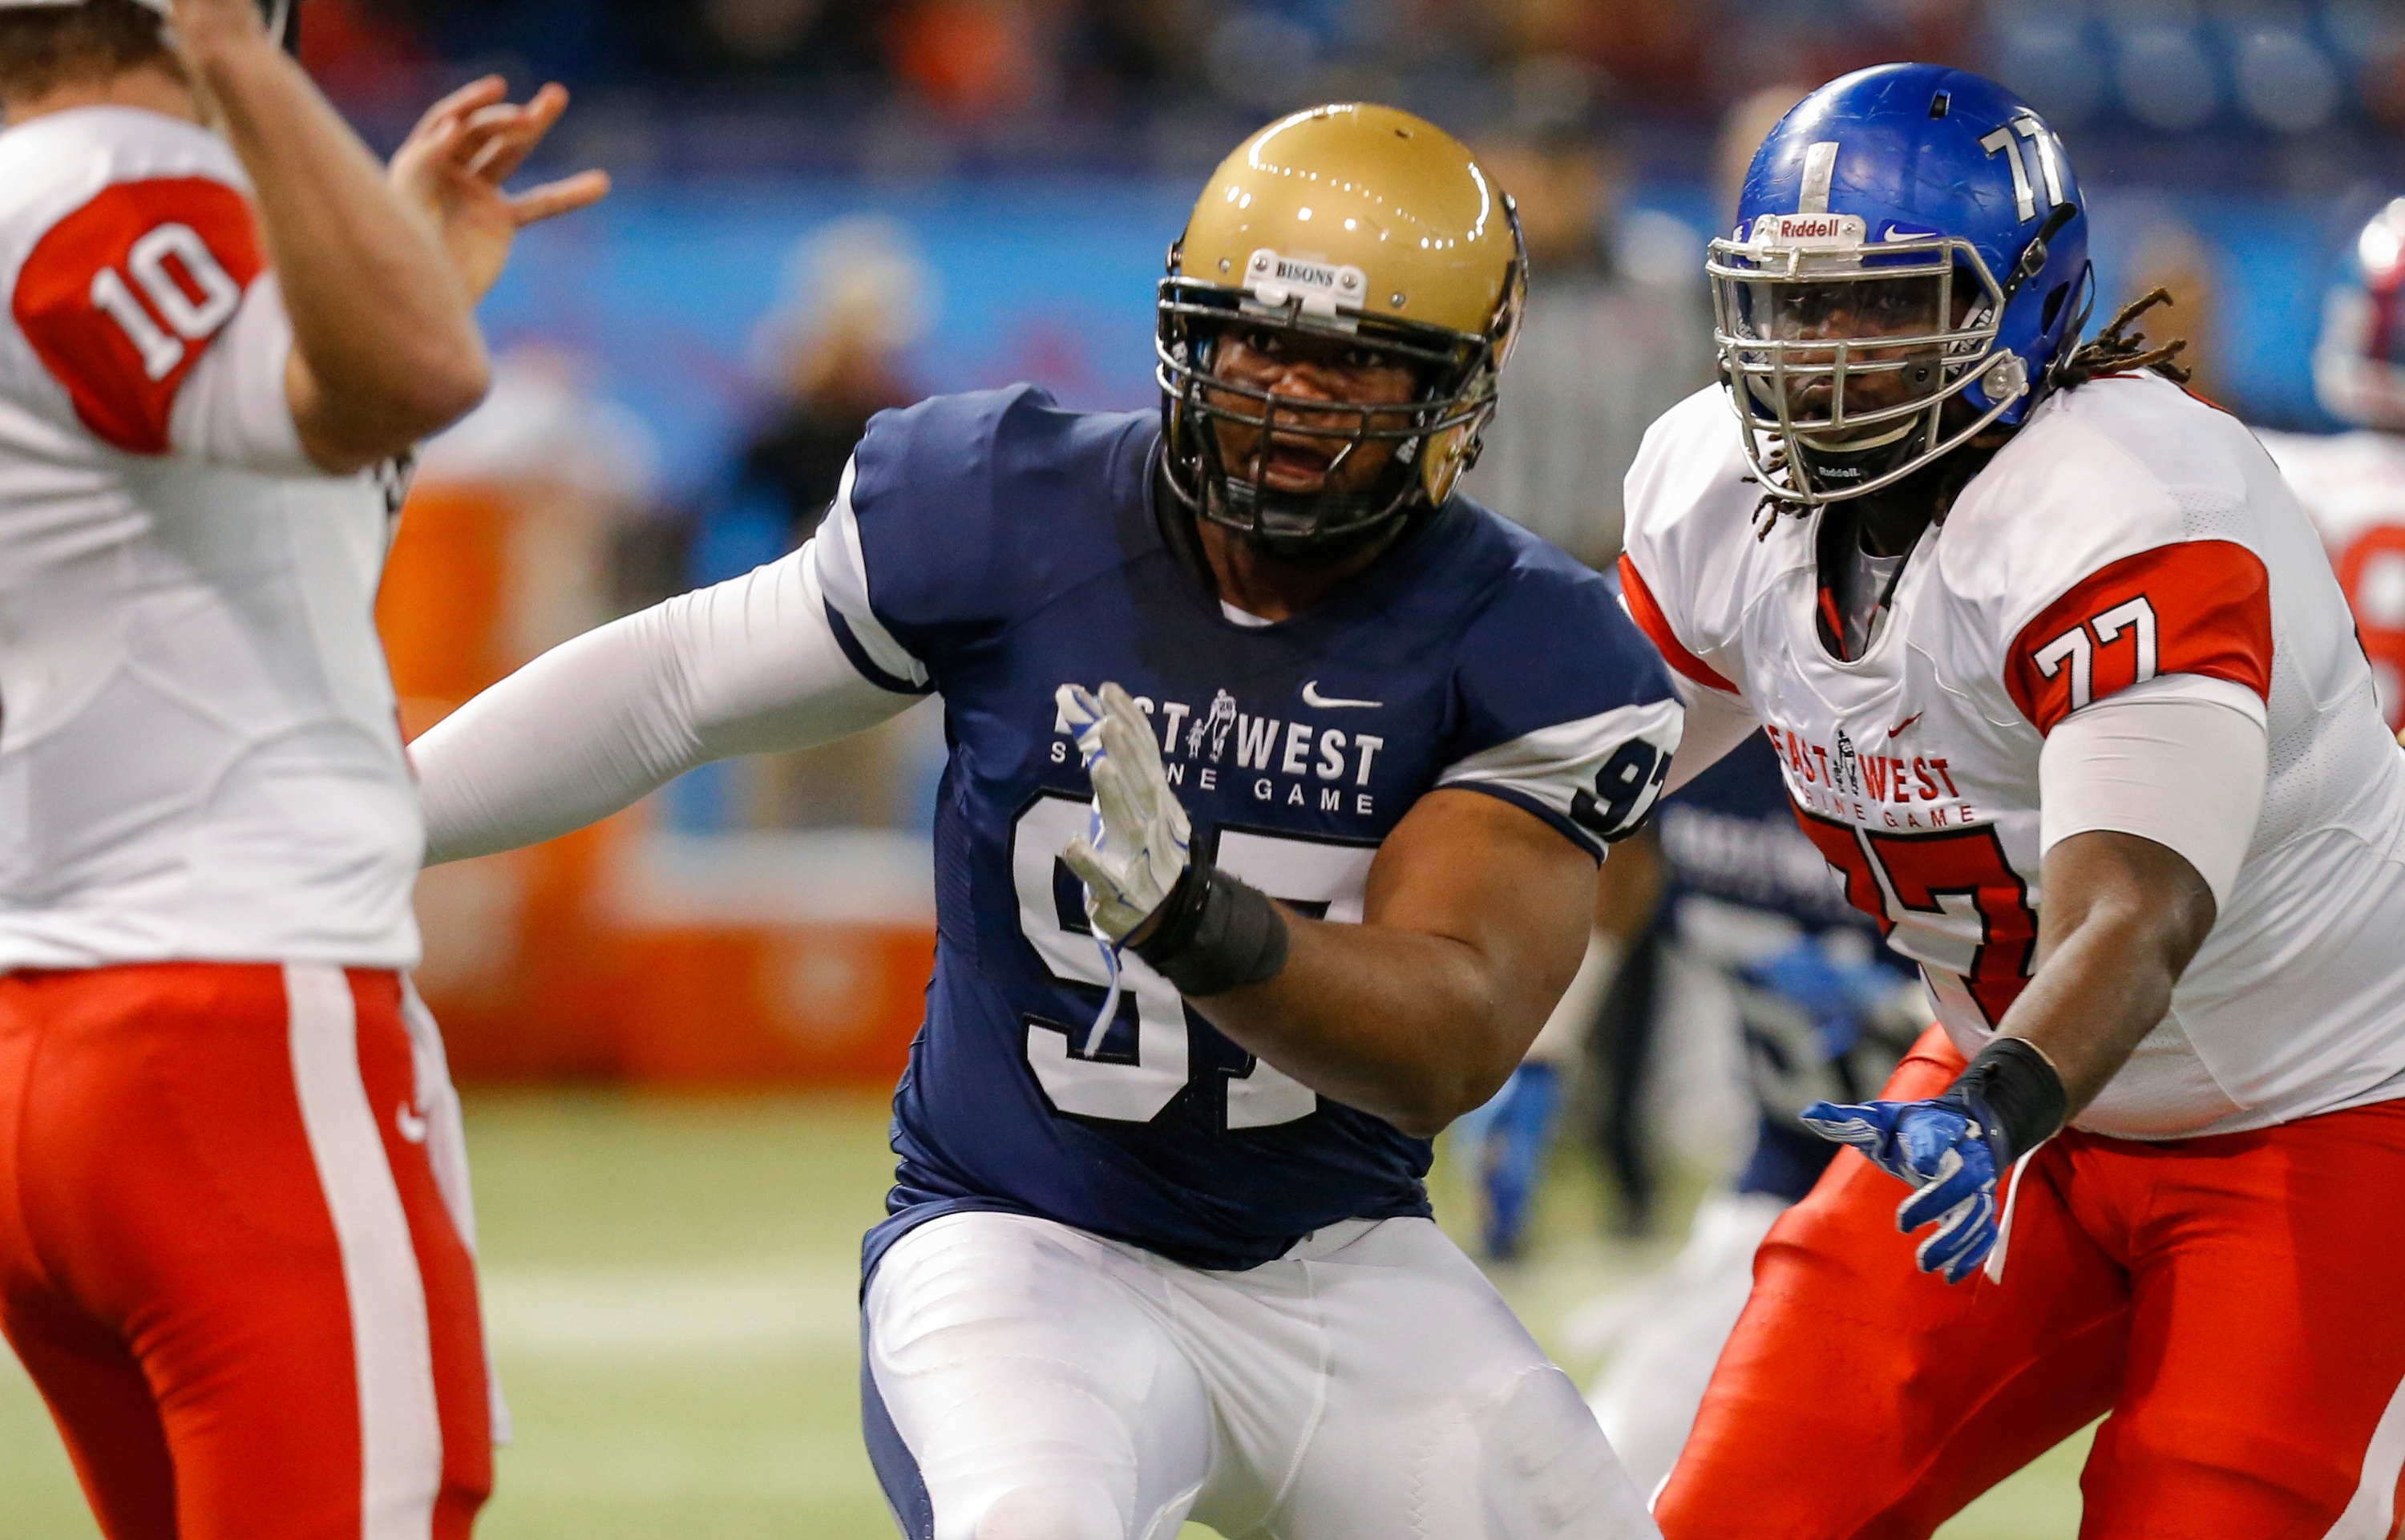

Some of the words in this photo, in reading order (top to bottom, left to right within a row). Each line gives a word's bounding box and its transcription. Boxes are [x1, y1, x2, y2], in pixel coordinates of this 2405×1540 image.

[1978, 116, 2065, 223] 77
[1781, 219, 1840, 237] Riddell
[90, 221, 241, 382] 10
[1276, 261, 1334, 286] BISONS
[1818, 466, 1861, 477] Riddell
[2031, 593, 2157, 711] 77
[1050, 741, 1218, 791] SNE
[1254, 778, 1373, 815] GAME
[1237, 713, 1384, 786] WEST
[1857, 754, 1959, 802] WEST
[1883, 805, 1975, 828] GAME
